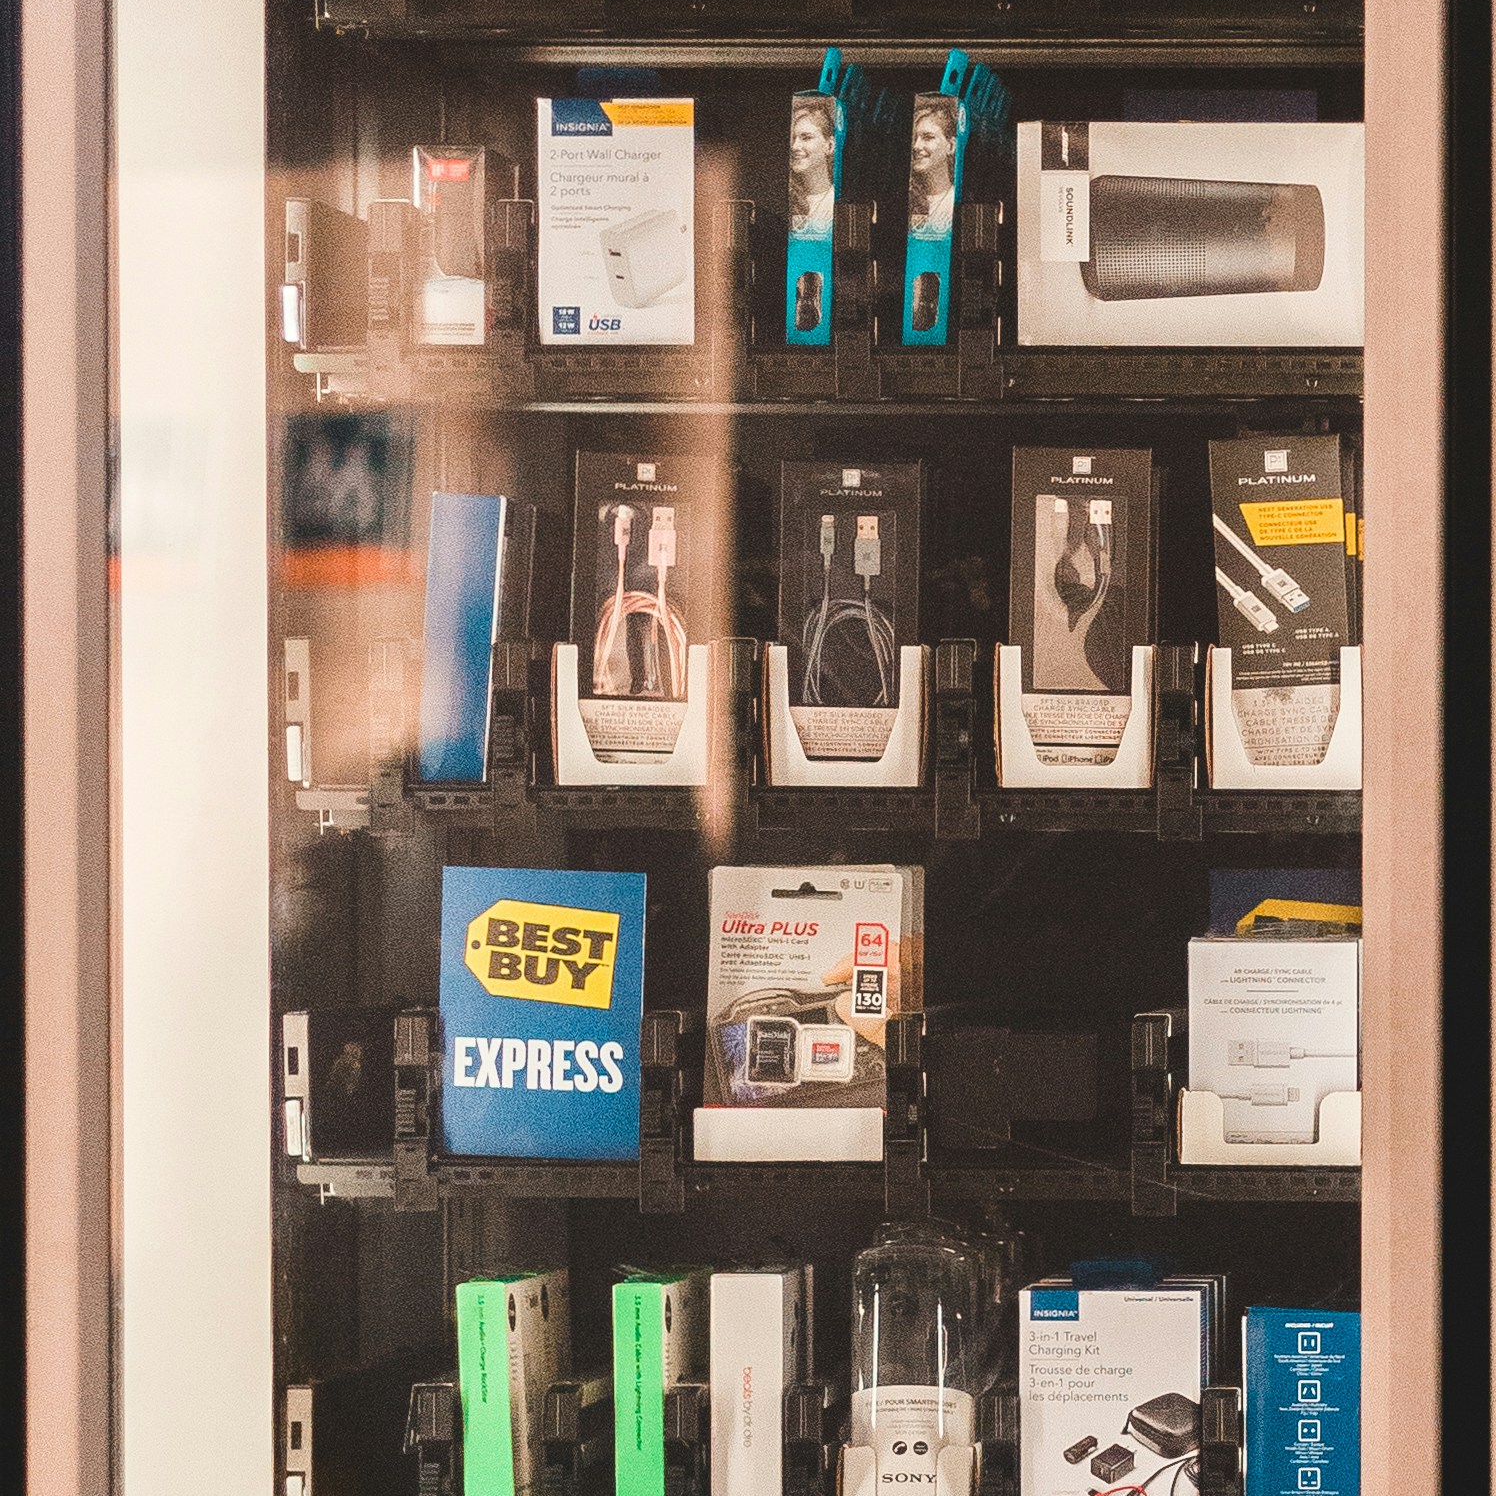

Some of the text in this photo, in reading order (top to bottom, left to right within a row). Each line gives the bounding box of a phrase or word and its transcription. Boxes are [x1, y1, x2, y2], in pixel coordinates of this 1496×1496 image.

[556, 122, 608, 132] INSIGNIA
[586, 150, 612, 161] Wall
[614, 150, 661, 161] Charger
[550, 172, 640, 185] Chargeur mural
[550, 187, 591, 197] 2 ports
[1065, 187, 1074, 245] SOUNDLINK
[588, 319, 621, 330] USB
[1051, 476, 1114, 486] PLATINUM
[1239, 474, 1316, 486] PLATINUM
[615, 483, 678, 493] PLATINUM
[820, 489, 883, 498] PLATINUM
[1067, 753, 1092, 763] iPhone
[722, 920, 819, 935] Ultra PLUS
[486, 916, 613, 960] BEST
[861, 934, 883, 947] 64
[487, 954, 600, 992] BUY
[856, 993, 882, 1006] 130
[454, 1035, 624, 1093] EXPRESS
[1029, 1331, 1097, 1343] 3-in-1 Travel
[1029, 1345, 1100, 1358] Charging Kit
[1029, 1364, 1133, 1378] Trousse de charge
[742, 1366, 753, 1400] beats
[1029, 1378, 1095, 1392] 3-en-1 pour
[1029, 1390, 1129, 1403] les déplacements
[882, 1473, 937, 1483] SONY
